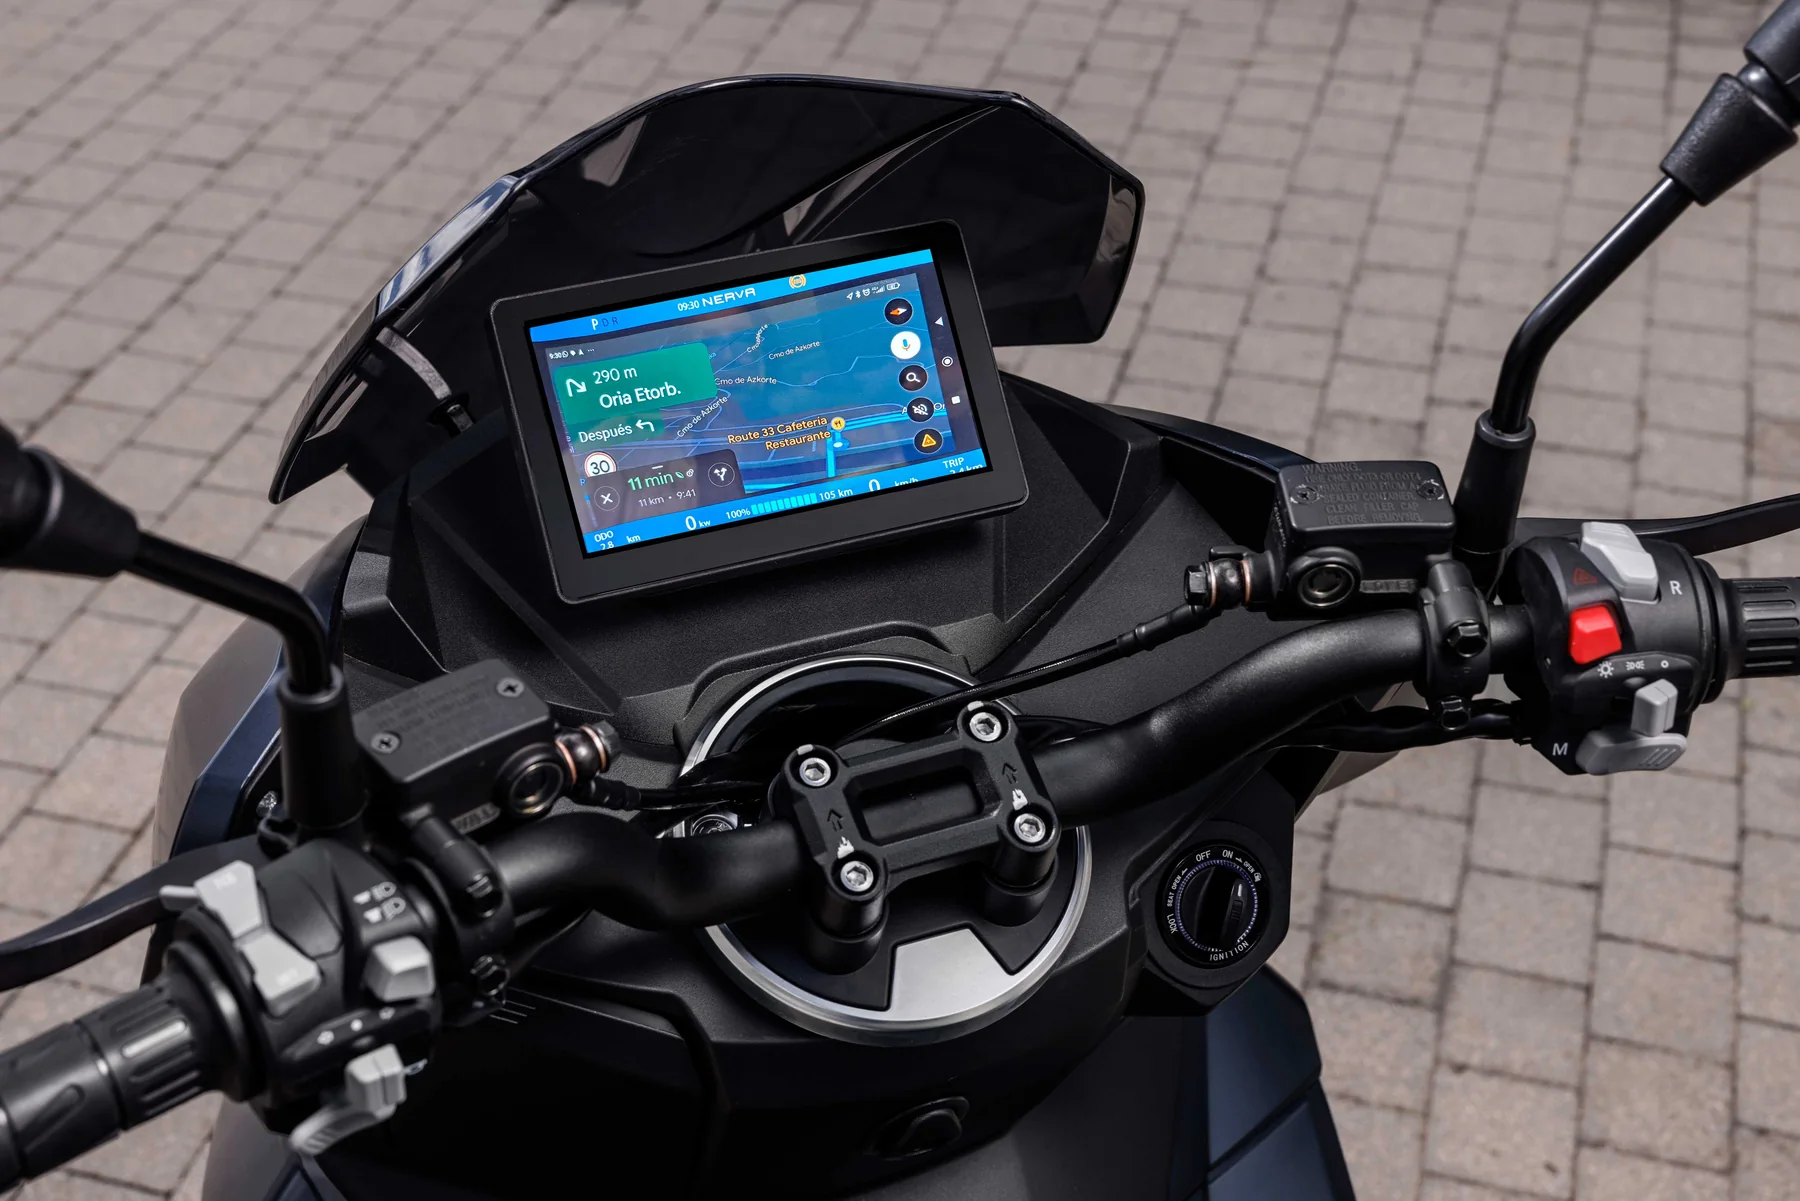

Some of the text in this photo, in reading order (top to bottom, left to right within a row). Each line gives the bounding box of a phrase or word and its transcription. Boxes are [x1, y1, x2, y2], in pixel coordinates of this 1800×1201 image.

[678, 287, 756, 311] 09:30 NERVA
[591, 316, 619, 330] P D R
[768, 350, 784, 360] Cmo
[795, 340, 820, 352] Azkorte
[593, 367, 638, 384] 290 m
[746, 376, 777, 384] Azkorte
[600, 382, 682, 408] Oria Etorb.
[676, 396, 728, 438] Cmo de Azkorte
[579, 424, 633, 444] Después
[728, 416, 828, 444] Route 33 Cafeteria
[766, 430, 831, 450] Restaurante
[590, 460, 610, 475] 30
[942, 457, 964, 469] TRIP
[628, 472, 674, 491] 11 min
[868, 479, 880, 492] 0
[639, 489, 696, 507] 11 km 9:41
[819, 488, 853, 501] 105 km
[726, 507, 751, 520] 100%
[685, 516, 697, 530] 0
[594, 530, 614, 543] ODO
[626, 534, 640, 543] km
[1670, 580, 1683, 596] R
[1552, 742, 1568, 756] M
[1196, 850, 1211, 862] OFF
[1222, 850, 1234, 859] ON
[1243, 861, 1255, 874] OPEN
[1167, 875, 1182, 907] SEAT OPEN
[1166, 914, 1178, 934] LOCK
[1210, 940, 1250, 962] IGNITION
